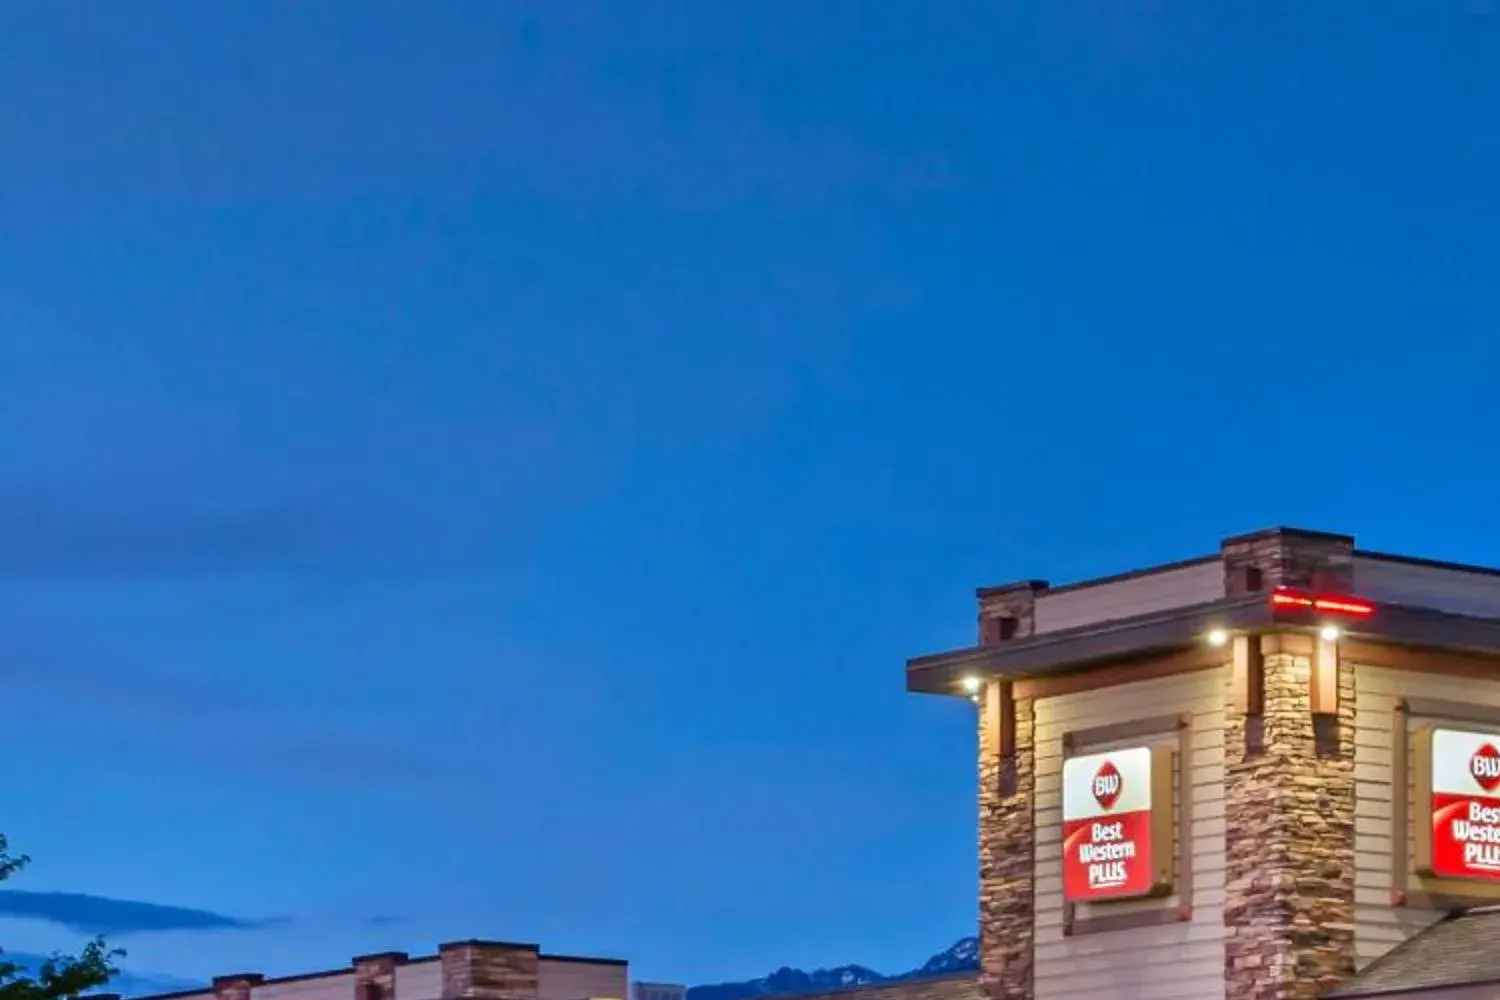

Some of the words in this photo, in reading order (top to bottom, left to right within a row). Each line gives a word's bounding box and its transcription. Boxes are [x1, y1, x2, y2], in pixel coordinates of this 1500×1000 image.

[1473, 755, 1500, 777] BW
[1095, 775, 1119, 796] BW
[1091, 822, 1122, 842] Best
[1079, 841, 1135, 863] Western
[1089, 862, 1126, 884] PLUS
